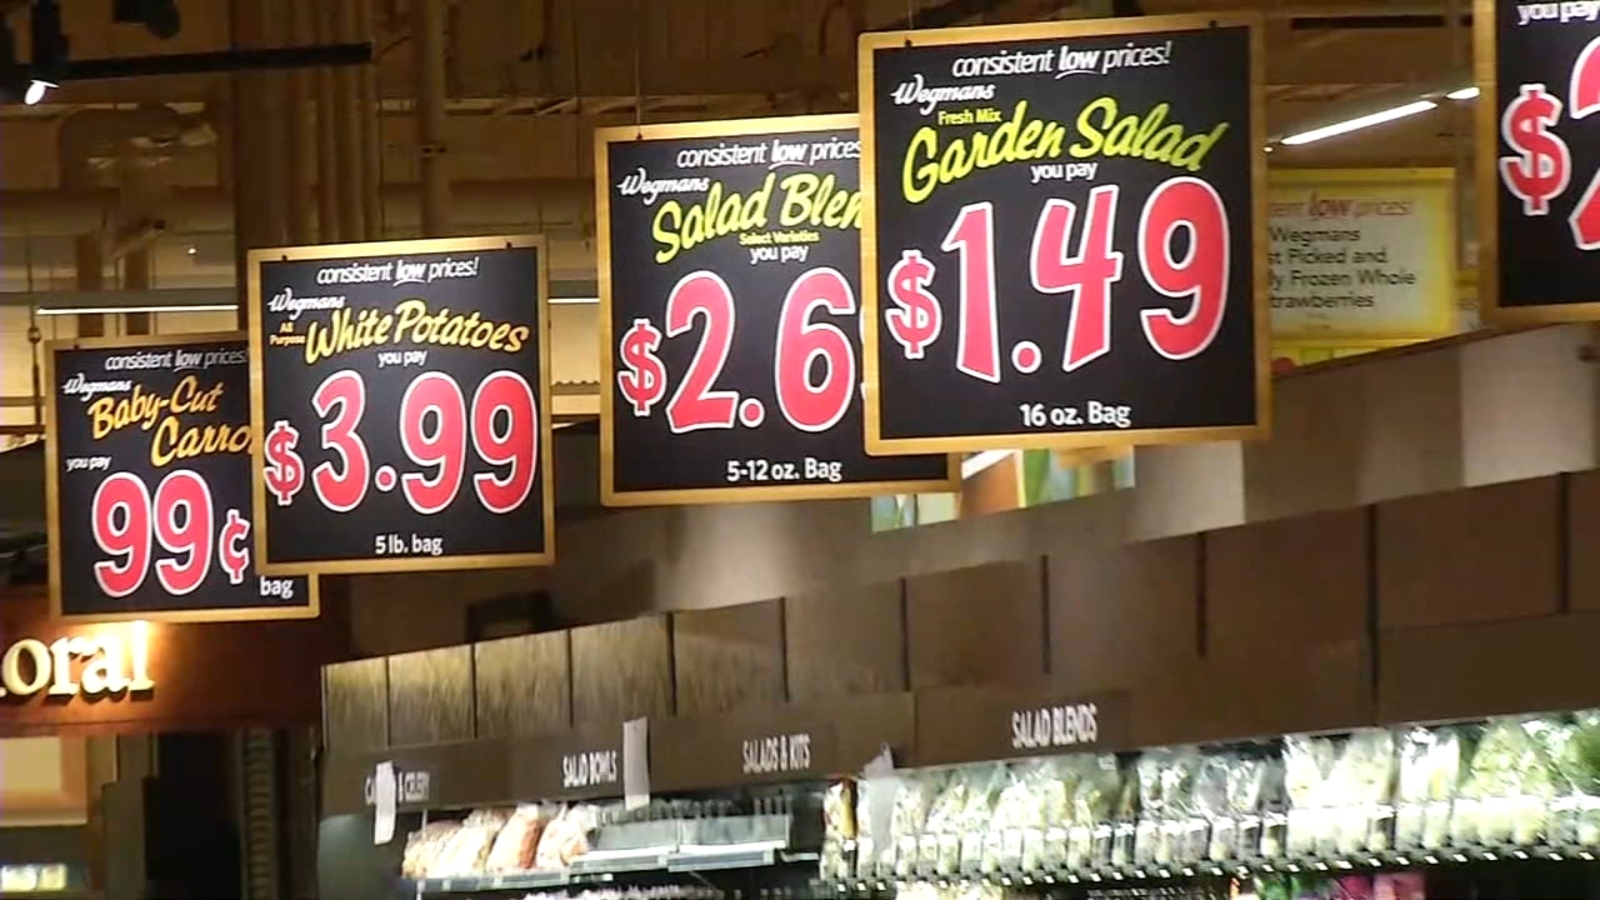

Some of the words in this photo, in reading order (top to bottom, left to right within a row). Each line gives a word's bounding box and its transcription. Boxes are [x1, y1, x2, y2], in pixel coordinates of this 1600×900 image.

[1516, 3, 1559, 25] you
[1560, 1, 1600, 23] pay
[952, 49, 1054, 78] consistent
[1055, 45, 1100, 79] low
[1102, 41, 1172, 74] prices!
[891, 74, 995, 115] Wegmans
[938, 110, 974, 126] Fresh
[976, 108, 1002, 123] Mix
[677, 142, 767, 169] consistent
[768, 139, 808, 170] low
[809, 136, 862, 166] prices
[902, 100, 1066, 203] Garden
[1070, 97, 1230, 172] Salad
[616, 167, 710, 205] Wegmans
[1030, 164, 1065, 183] you
[1066, 161, 1098, 182] pay
[652, 172, 776, 264] Salad
[780, 173, 863, 230] Blen
[739, 232, 772, 246] Select
[773, 230, 820, 244] Varieties
[1268, 226, 1361, 247] Wegmans
[750, 247, 778, 264] you
[781, 245, 809, 262] pay
[1288, 248, 1346, 264] Picked
[1352, 245, 1388, 263] and
[316, 260, 392, 285] consistent
[393, 259, 427, 287] low
[427, 257, 480, 282] prices!
[886, 176, 1230, 383] $1.49
[1290, 269, 1351, 286] Frozen
[1357, 268, 1417, 286] Whole
[267, 287, 346, 320] Wegmans
[1268, 291, 1374, 309] trawberries
[268, 334, 306, 347] Purpose
[305, 307, 393, 364] White
[393, 300, 529, 352] Potatoes
[105, 352, 172, 371] consistent
[173, 350, 201, 372] low
[378, 351, 402, 367] you
[403, 350, 428, 366] pay
[617, 267, 864, 433] $2.6
[62, 372, 132, 401] Wegmans
[87, 375, 224, 439] Baby-Cut
[1020, 404, 1046, 426] 16
[1050, 406, 1083, 425] oz.
[1088, 401, 1131, 428] Bag
[151, 415, 252, 467] Carro
[263, 370, 538, 514] $3.99
[66, 456, 89, 472] you
[89, 455, 112, 470] pay
[727, 460, 770, 482] 5-12
[772, 461, 800, 481] oz.
[804, 458, 842, 482] Bag
[375, 535, 387, 554] 5
[388, 535, 409, 554] lb.
[411, 533, 443, 556] bag
[259, 576, 294, 599] bag
[0, 620, 155, 696] oral
[1012, 705, 1051, 750] SALAD
[1052, 702, 1097, 747] BLENDS
